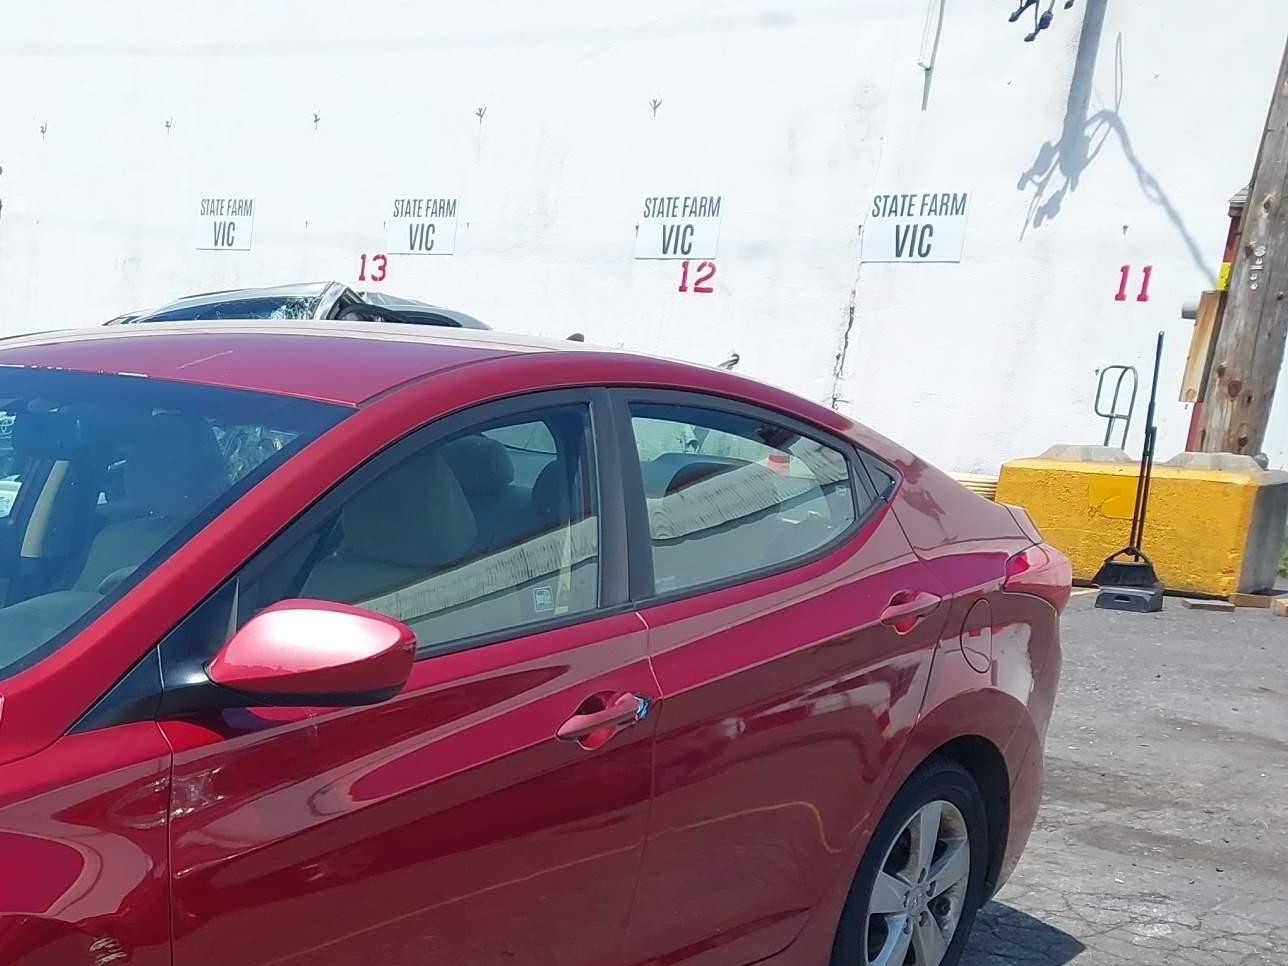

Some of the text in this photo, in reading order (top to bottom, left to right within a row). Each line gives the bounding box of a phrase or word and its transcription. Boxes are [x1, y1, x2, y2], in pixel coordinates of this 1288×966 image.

[200, 199, 253, 217] STATE FARM
[392, 199, 457, 218] STATE FARM
[643, 195, 722, 218] STATE FARM
[871, 192, 968, 218] STATE FARM
[213, 221, 236, 248] VIC
[409, 222, 436, 252] VIC
[661, 223, 695, 256] VIC
[894, 223, 934, 258] VIC
[358, 253, 388, 282] 13
[678, 260, 717, 294] 12
[1114, 264, 1153, 302] 11
